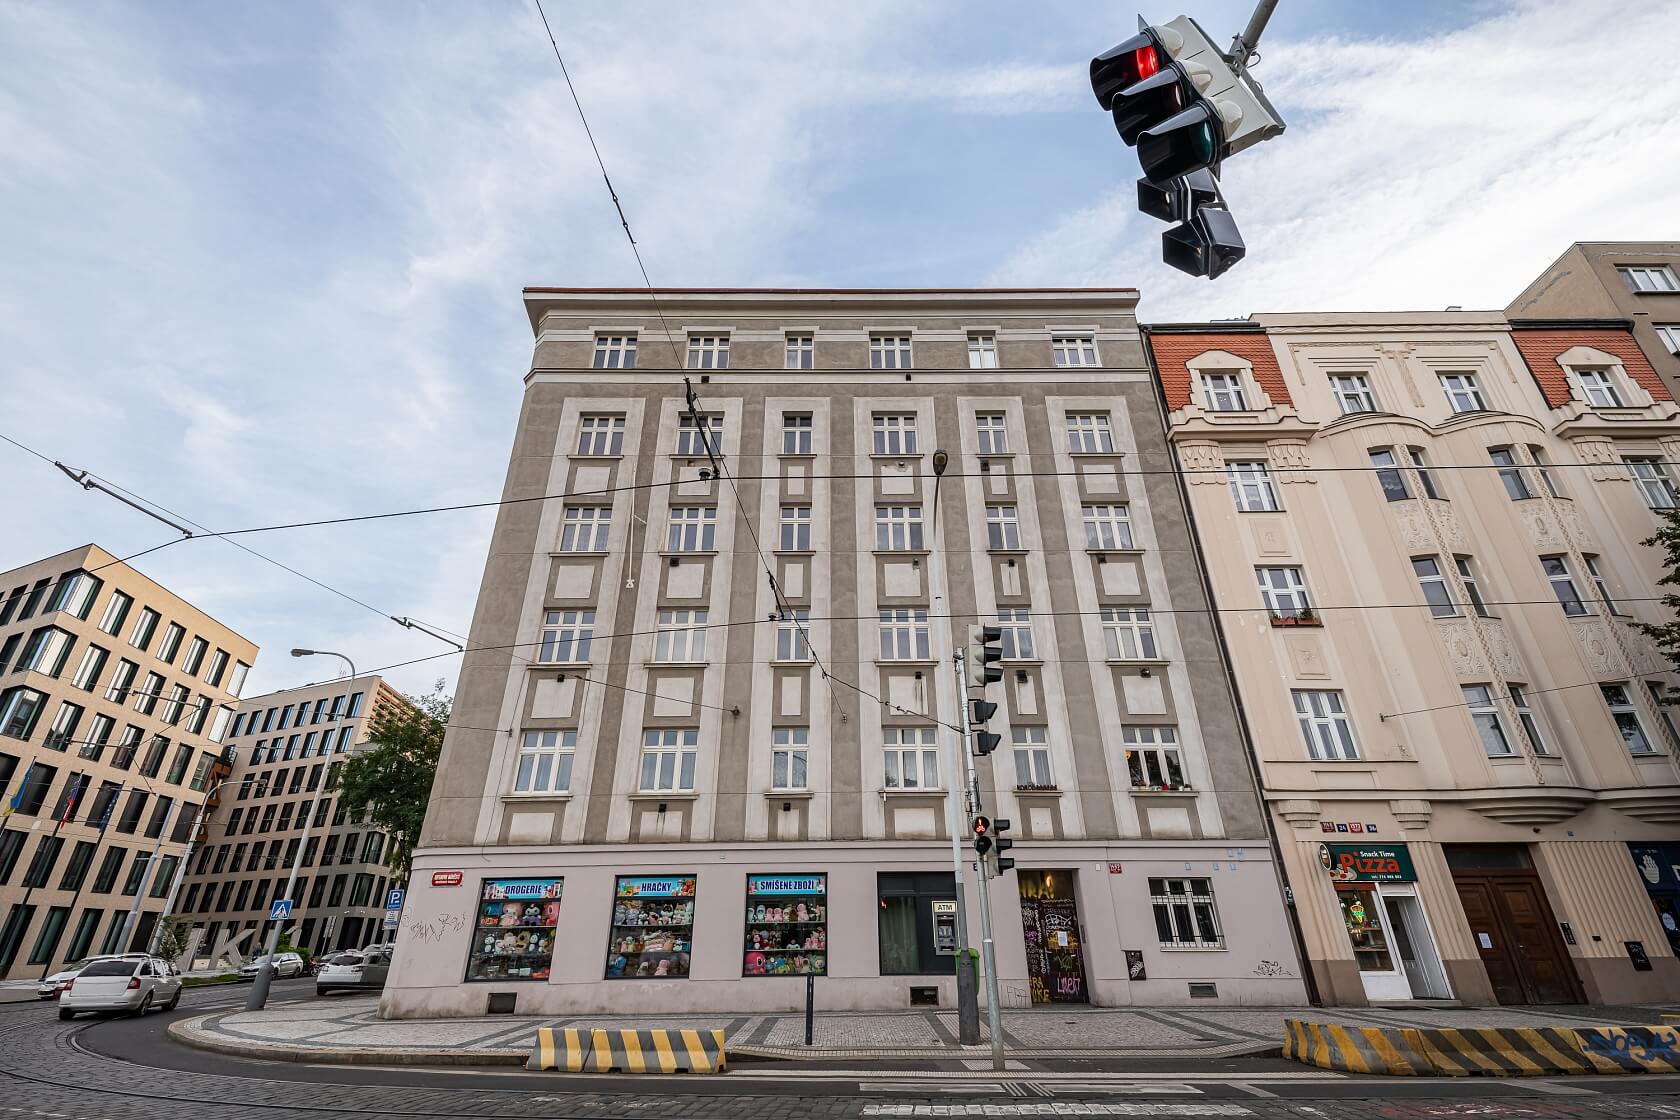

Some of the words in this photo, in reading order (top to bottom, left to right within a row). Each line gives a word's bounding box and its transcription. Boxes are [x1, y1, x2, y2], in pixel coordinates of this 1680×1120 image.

[1360, 850, 1378, 858] Snack
[1379, 850, 1395, 858] Time
[1340, 852, 1401, 873] Pizza
[505, 885, 542, 895] DROGERIE
[641, 881, 672, 892] HRAČKY
[760, 879, 793, 890] SMÍŠENÉ
[793, 879, 814, 890] ZBOŽÍ
[390, 892, 400, 905] P
